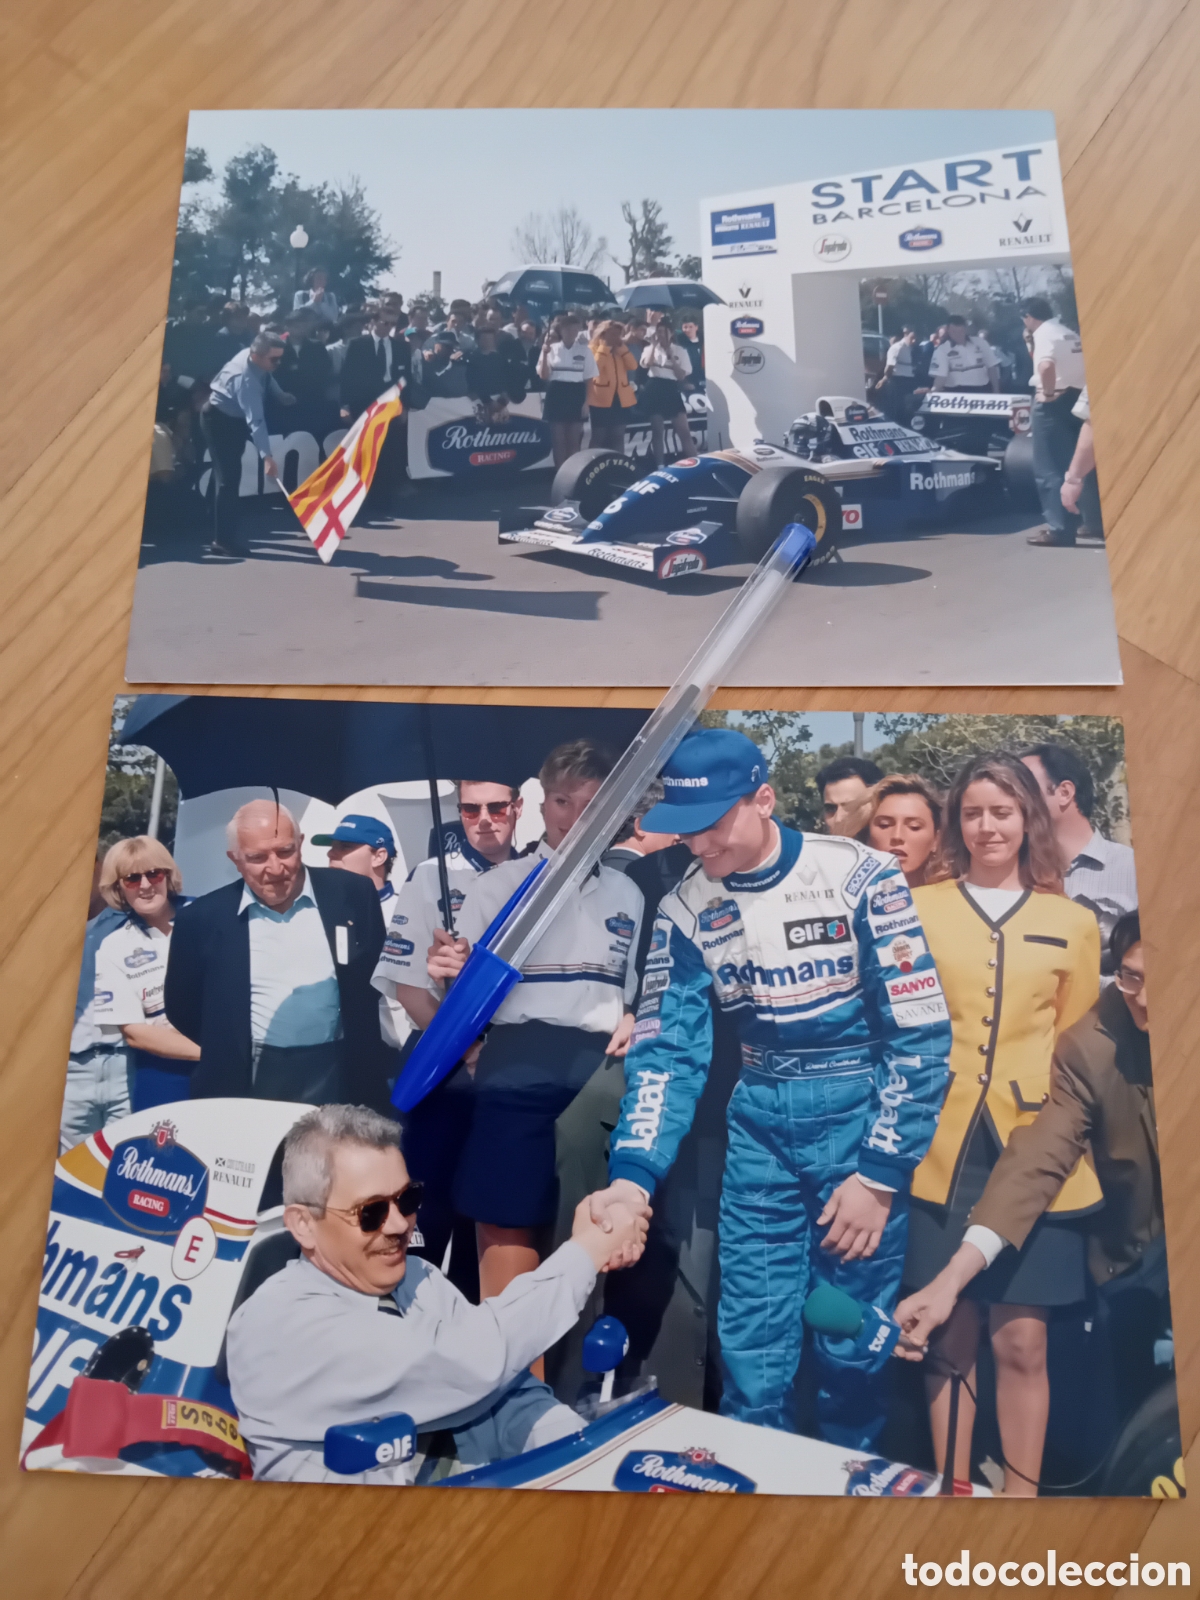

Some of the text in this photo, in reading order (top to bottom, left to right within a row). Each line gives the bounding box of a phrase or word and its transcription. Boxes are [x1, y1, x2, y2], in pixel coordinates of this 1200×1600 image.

[811, 149, 1042, 209] START
[812, 186, 1047, 225] BARCELONA
[999, 233, 1052, 247] RENAULT
[728, 299, 763, 309] RENAULT
[441, 425, 541, 450] Rothmans
[849, 427, 907, 441] Rothmans
[477, 451, 511, 463] RACING
[853, 440, 880, 459] elf
[803, 474, 826, 485] EAGLE
[910, 470, 976, 490] Rothmans
[730, 870, 781, 888] Rothmans
[846, 856, 881, 894] sparco
[784, 888, 835, 903] RENAULT
[788, 922, 825, 944] elf
[890, 976, 936, 996] SANYO
[895, 1003, 946, 1023] SAVANE
[869, 1051, 922, 1155] Labatt
[117, 1146, 196, 1198] Rothmans
[213, 1170, 254, 1188] RENAULT
[133, 1194, 164, 1212] RACING
[183, 1234, 203, 1264] E
[375, 1434, 414, 1464] elf
